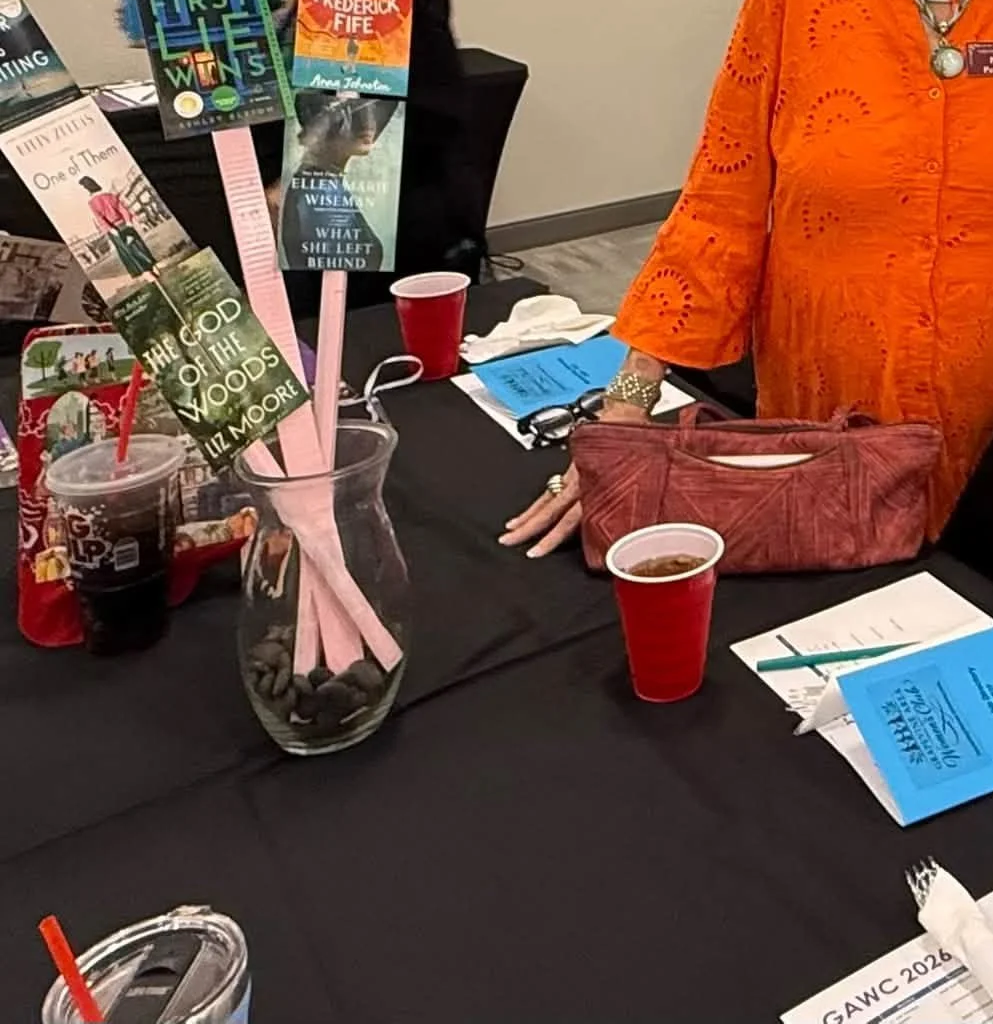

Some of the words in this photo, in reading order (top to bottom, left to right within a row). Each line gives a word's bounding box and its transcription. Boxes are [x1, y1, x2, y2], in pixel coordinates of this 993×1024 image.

[155, 11, 258, 61] LIE
[333, 13, 375, 34] FIFE
[0, 50, 48, 83] ITING
[310, 73, 341, 88] Anna
[33, 171, 66, 190] One
[68, 155, 81, 176] of
[77, 145, 119, 167] Them
[291, 177, 339, 190] ELLEN
[305, 193, 376, 208] WISEMAN
[302, 241, 331, 254] SHE
[336, 242, 373, 256] LEFT
[315, 227, 362, 241] WHAT
[307, 256, 366, 270] BEHIND
[142, 337, 180, 375] THE
[179, 297, 241, 347] GOD
[178, 355, 208, 387] OF
[208, 331, 247, 366] THE
[178, 346, 280, 424] WOODS
[204, 431, 231, 459] LIZ
[228, 379, 299, 441] MOORE
[823, 978, 899, 1024] GAWC
[900, 948, 953, 984] 2026
